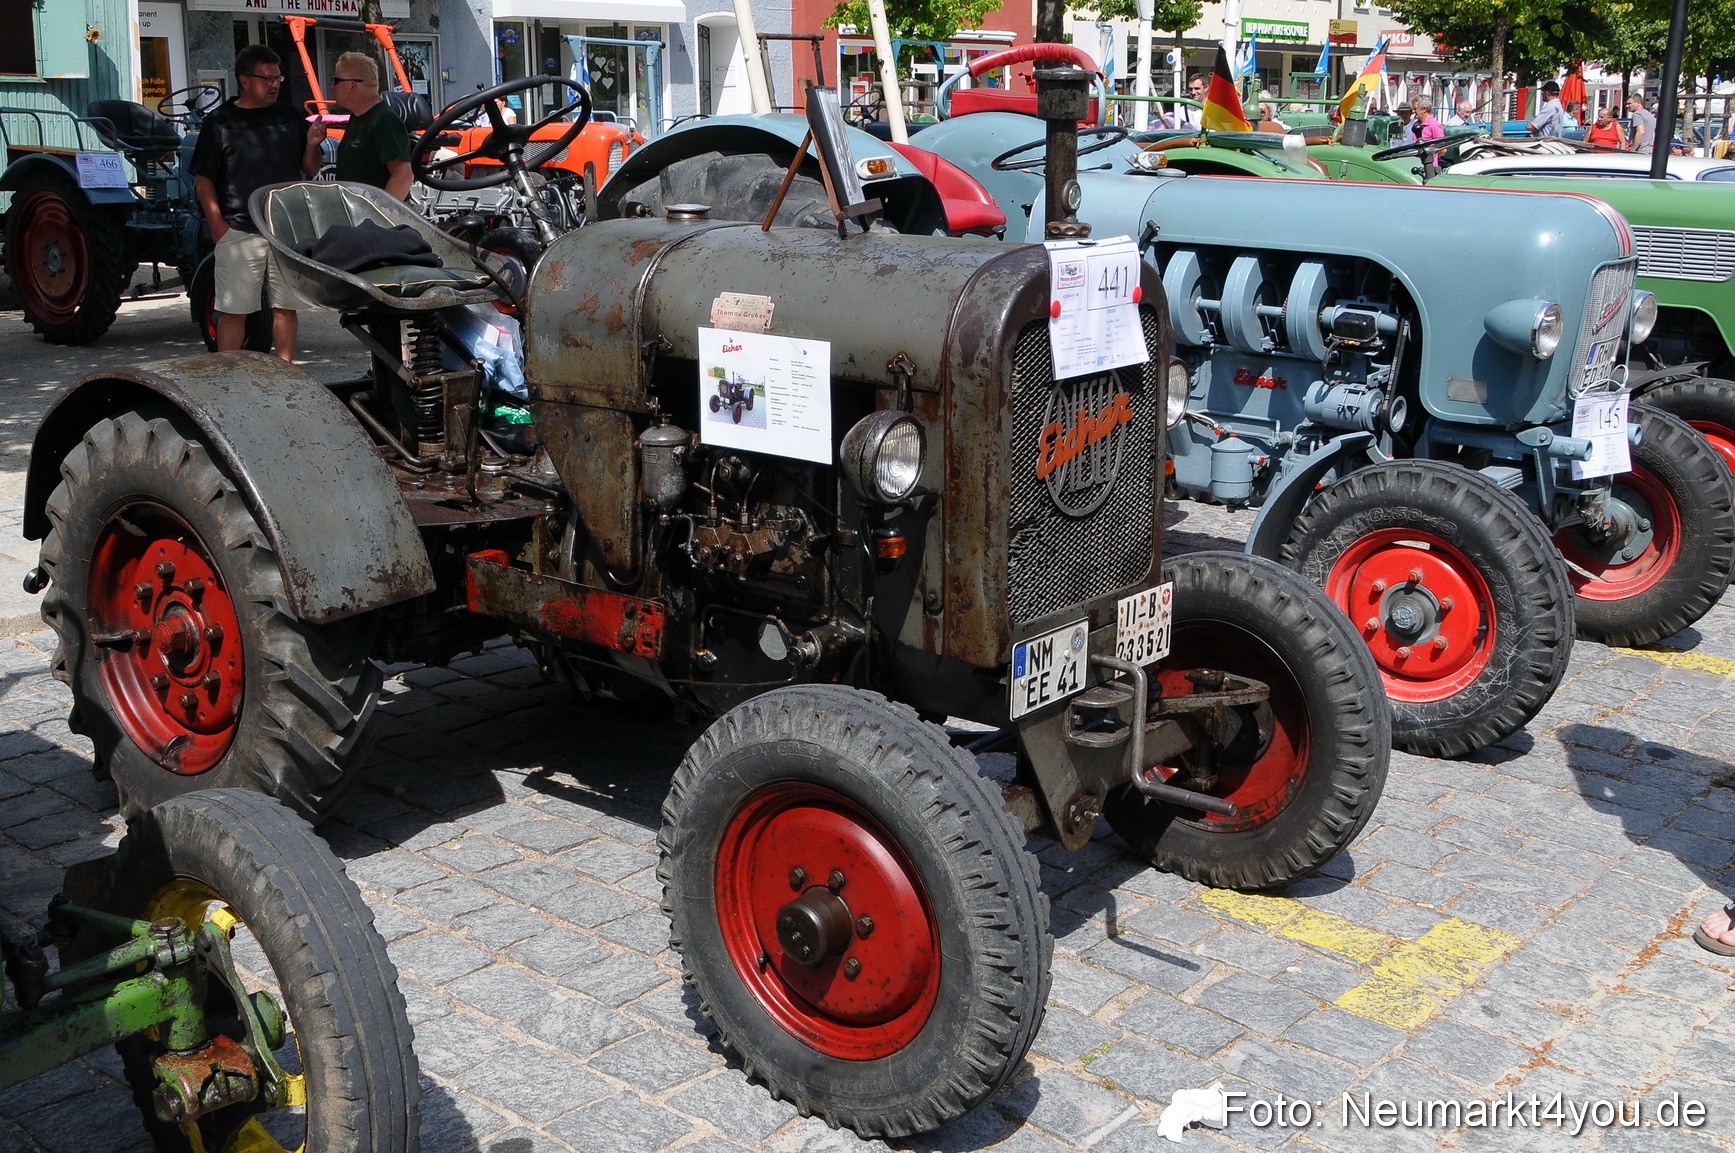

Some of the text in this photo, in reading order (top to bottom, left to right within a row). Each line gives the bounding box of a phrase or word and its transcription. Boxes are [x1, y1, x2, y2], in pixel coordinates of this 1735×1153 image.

[281, 0, 300, 9] THE
[1381, 32, 1411, 44] NKD
[99, 158, 118, 169] 466
[1098, 265, 1128, 299] 441
[743, 311, 767, 319] Gruber
[722, 344, 743, 353] Eicher
[1233, 367, 1288, 390] Eicher
[1599, 407, 1621, 429] 145
[1036, 392, 1134, 480] Eicher
[1029, 637, 1054, 675] NM
[1027, 661, 1079, 709] EE 41
